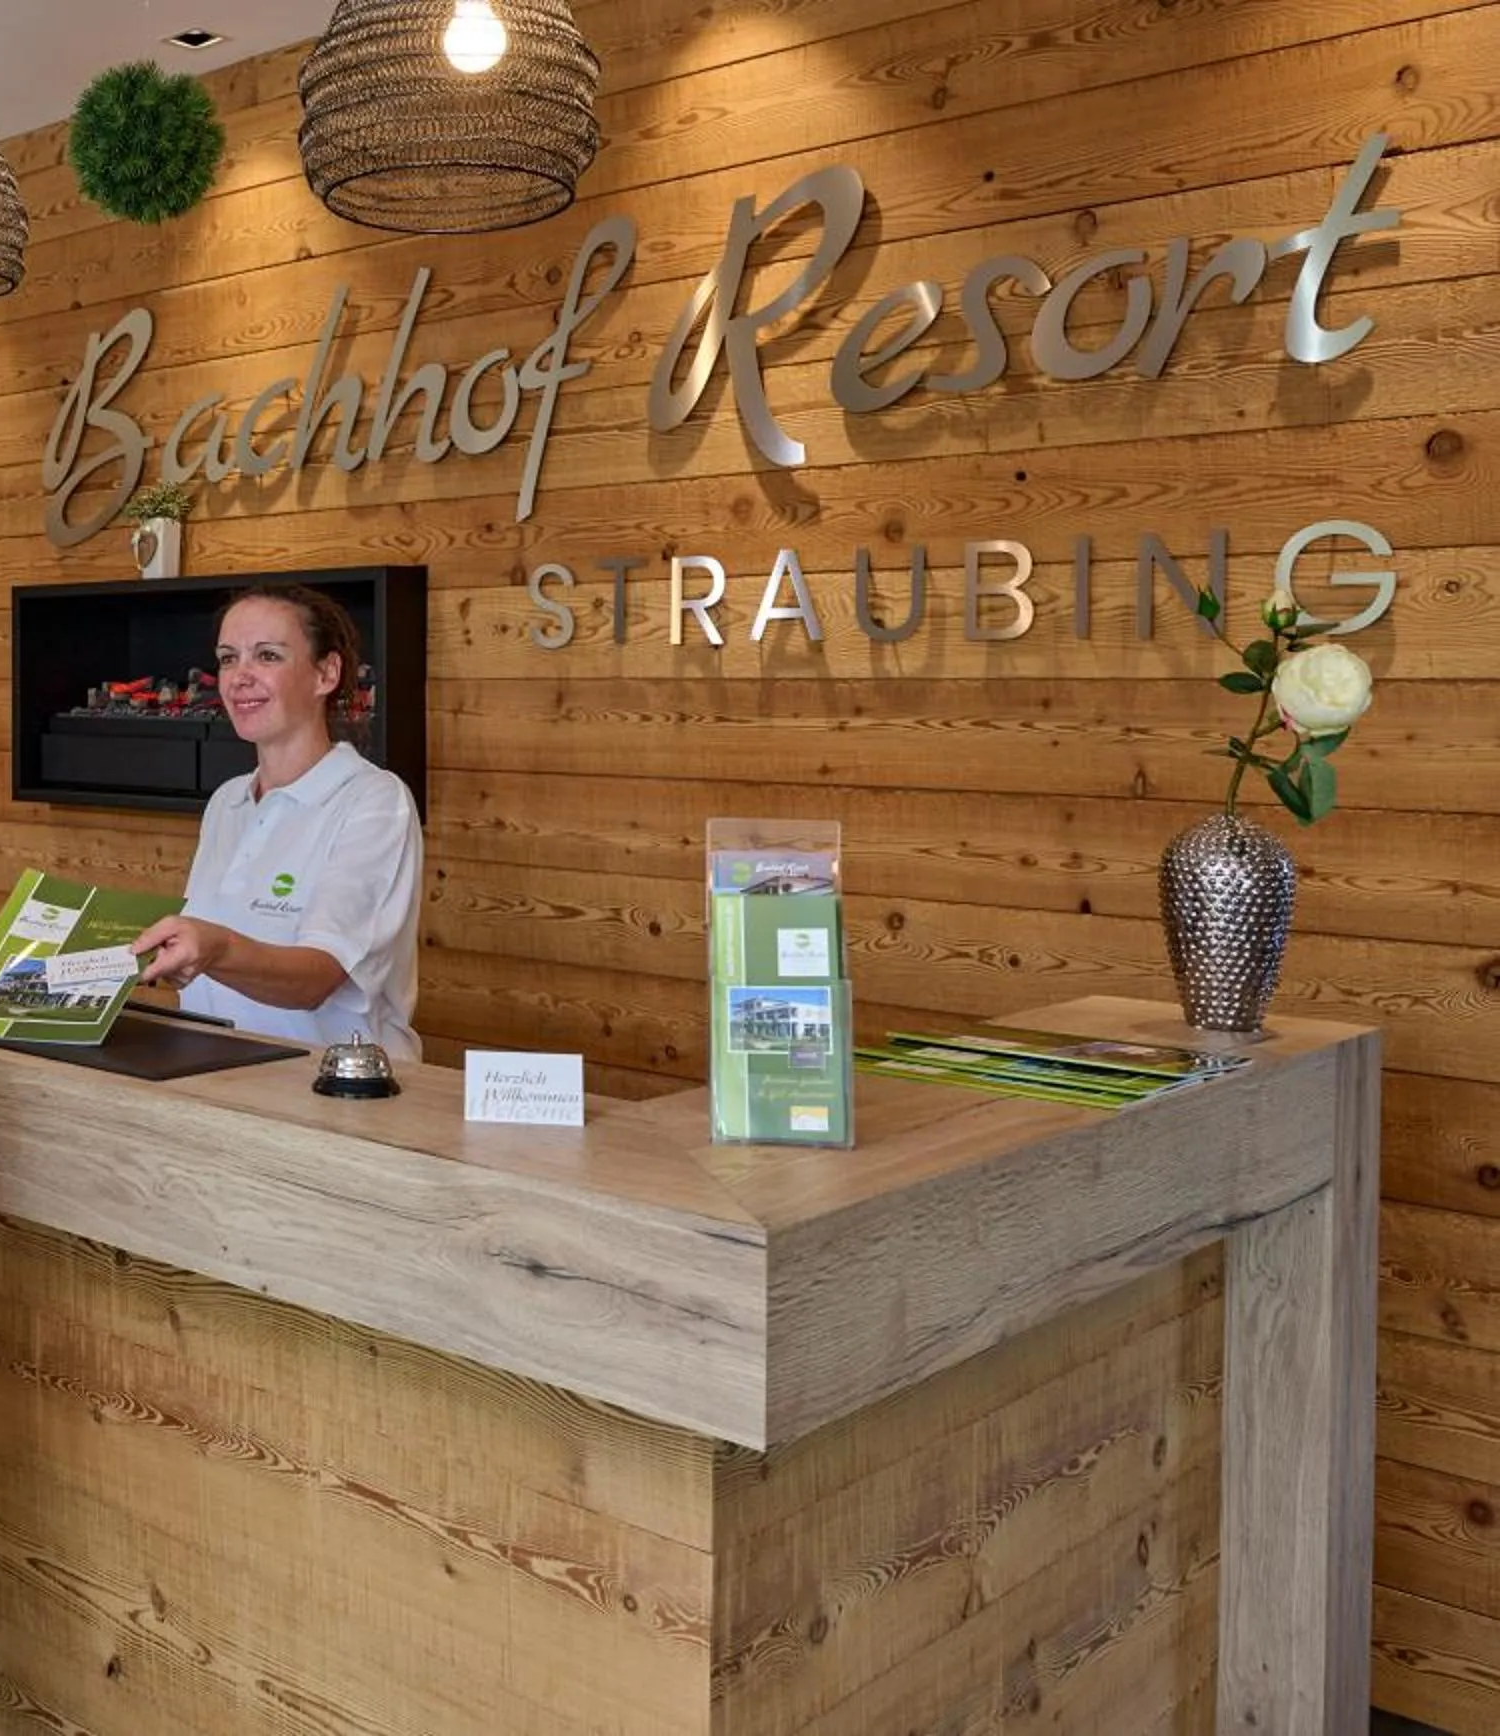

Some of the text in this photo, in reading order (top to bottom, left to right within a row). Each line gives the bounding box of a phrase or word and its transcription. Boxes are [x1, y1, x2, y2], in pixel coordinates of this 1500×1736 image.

[42, 133, 1400, 548] Bachhof Resort
[527, 520, 1397, 650] STRAUBING
[484, 1069, 547, 1085] Herzlich
[484, 1086, 579, 1103] Willkommen
